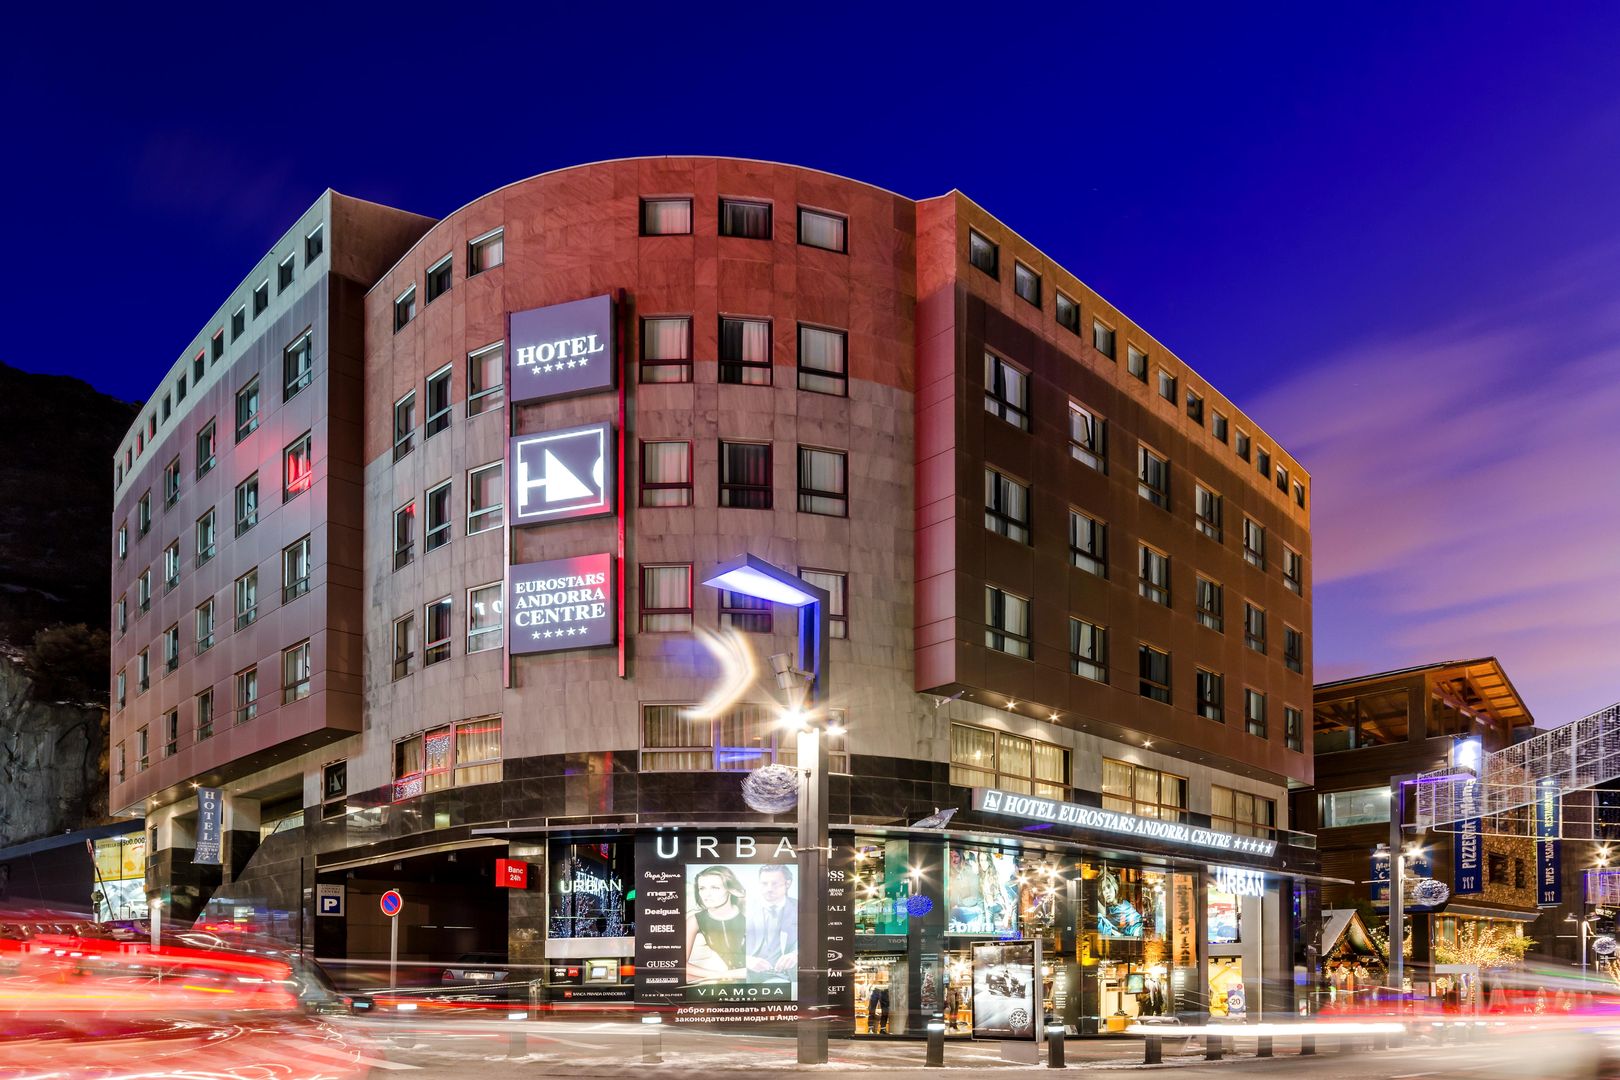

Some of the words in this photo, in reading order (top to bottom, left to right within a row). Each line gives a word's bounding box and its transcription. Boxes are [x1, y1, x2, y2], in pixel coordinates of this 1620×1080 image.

[517, 334, 604, 367] HOTEL
[515, 572, 605, 594] EUROSTARS
[515, 588, 606, 609] ANDORRA
[515, 602, 606, 627] CENTRE
[204, 791, 215, 841] HOTEL
[1545, 791, 1554, 827] RESTAURANT
[1003, 795, 1056, 819] HOTEL
[1058, 806, 1135, 833] EUROSTARS
[1137, 820, 1190, 842] ANDORRA
[1191, 829, 1231, 848] CENTRE
[657, 836, 833, 859] URBA
[1461, 819, 1477, 869] PIZZERIA
[508, 866, 523, 874] Banc
[828, 870, 844, 879] SS
[1546, 867, 1554, 885] TAPES
[561, 879, 621, 893] URBAN
[1217, 873, 1264, 896] URBAN
[324, 898, 337, 911] P
[650, 924, 675, 932] DIESEL
[677, 1006, 704, 1014] добро
